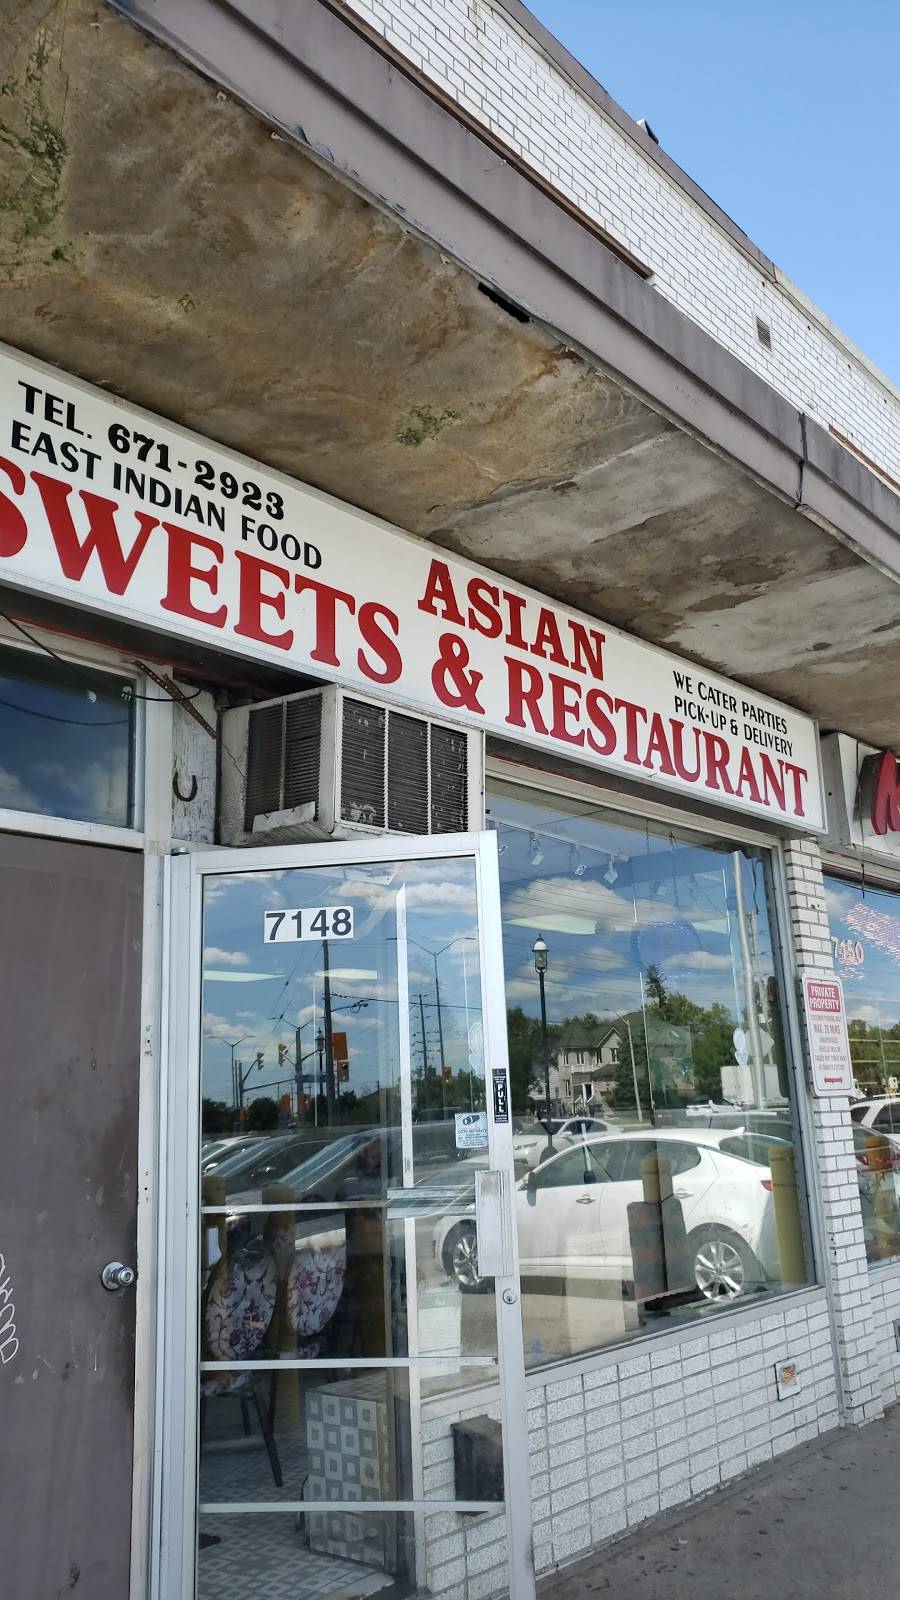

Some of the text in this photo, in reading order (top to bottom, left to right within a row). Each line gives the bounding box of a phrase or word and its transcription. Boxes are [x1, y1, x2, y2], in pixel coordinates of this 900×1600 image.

[18, 380, 285, 521] TEL. 671-2923
[11, 420, 323, 570] EAST INDIAN FOOD
[418, 558, 606, 681] ASIAN
[431, 632, 485, 715] &
[504, 655, 808, 818] RESTAURANT
[673, 671, 788, 735] WE CATER PARTIES
[674, 695, 793, 757] PICK-UP & DELIVERY
[265, 908, 352, 940] 7148
[809, 997, 839, 1010] PROPERTY
[810, 985, 836, 998] PRIVATE
